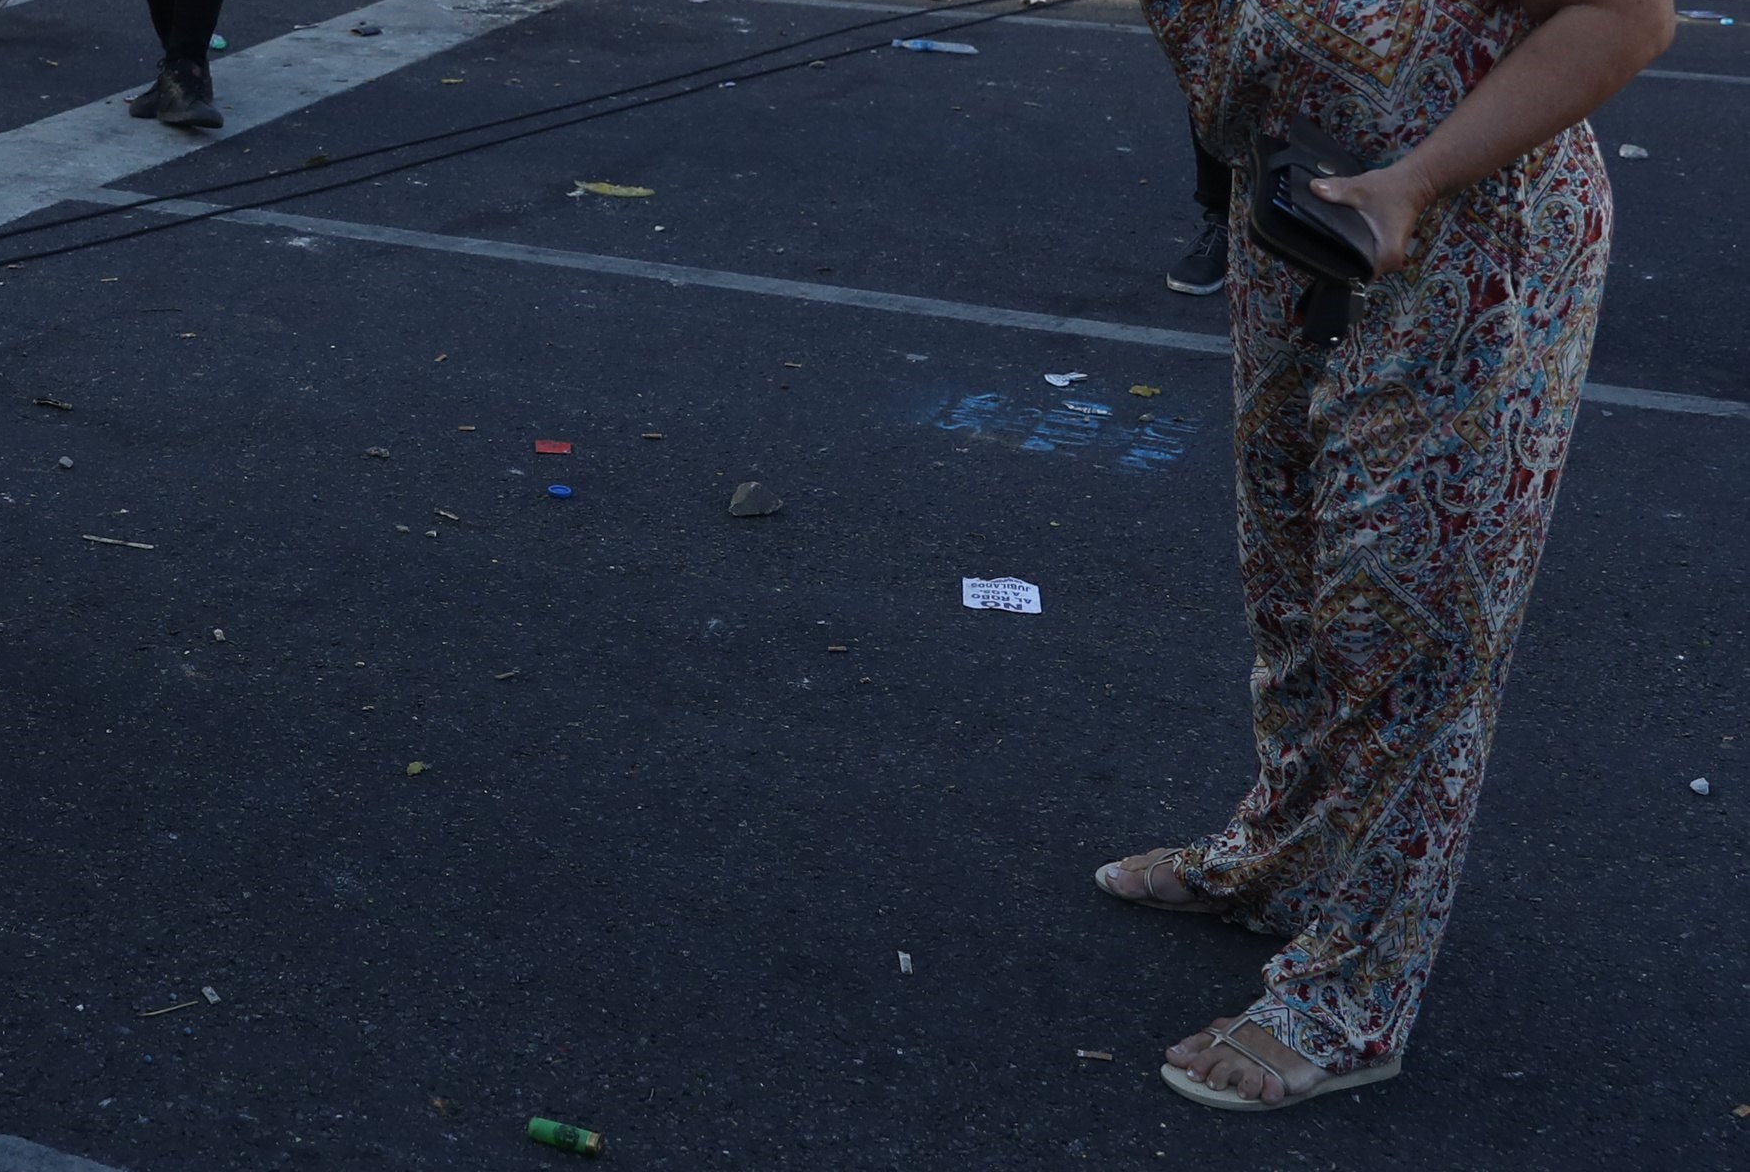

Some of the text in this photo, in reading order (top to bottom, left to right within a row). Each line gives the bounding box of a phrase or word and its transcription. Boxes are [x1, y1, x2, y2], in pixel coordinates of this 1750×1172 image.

[971, 583, 1032, 592] JUBILADOS
[971, 593, 1010, 601] ROBO
[981, 600, 1023, 610] NO
